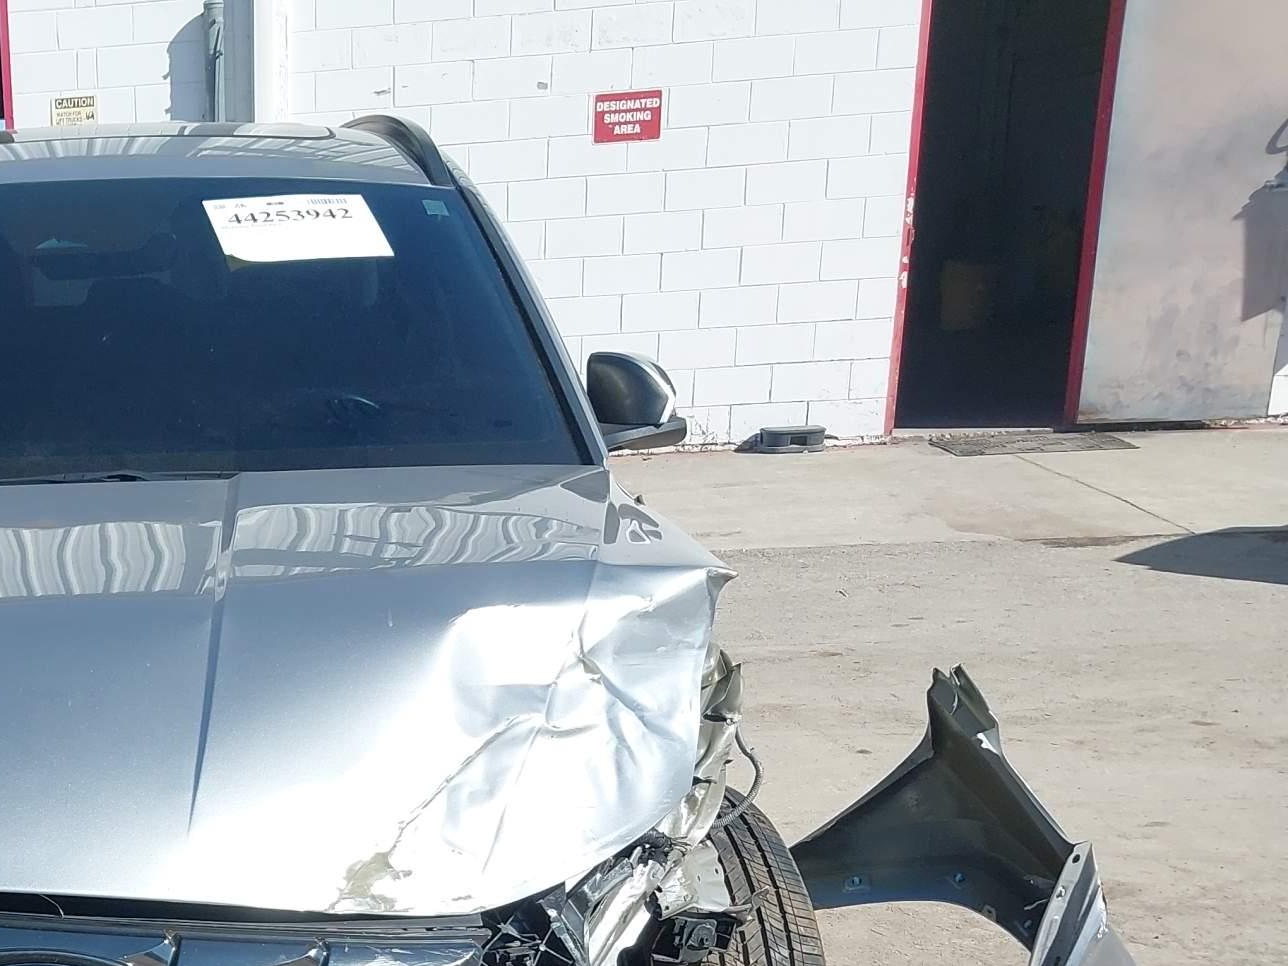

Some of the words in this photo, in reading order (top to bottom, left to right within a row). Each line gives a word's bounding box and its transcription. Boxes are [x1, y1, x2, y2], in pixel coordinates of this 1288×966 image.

[56, 97, 94, 109] CAUTION
[596, 98, 660, 111] DESIGNATED
[603, 110, 652, 123] SMOKING
[614, 124, 641, 135] AREA
[228, 208, 353, 225] 44253942
